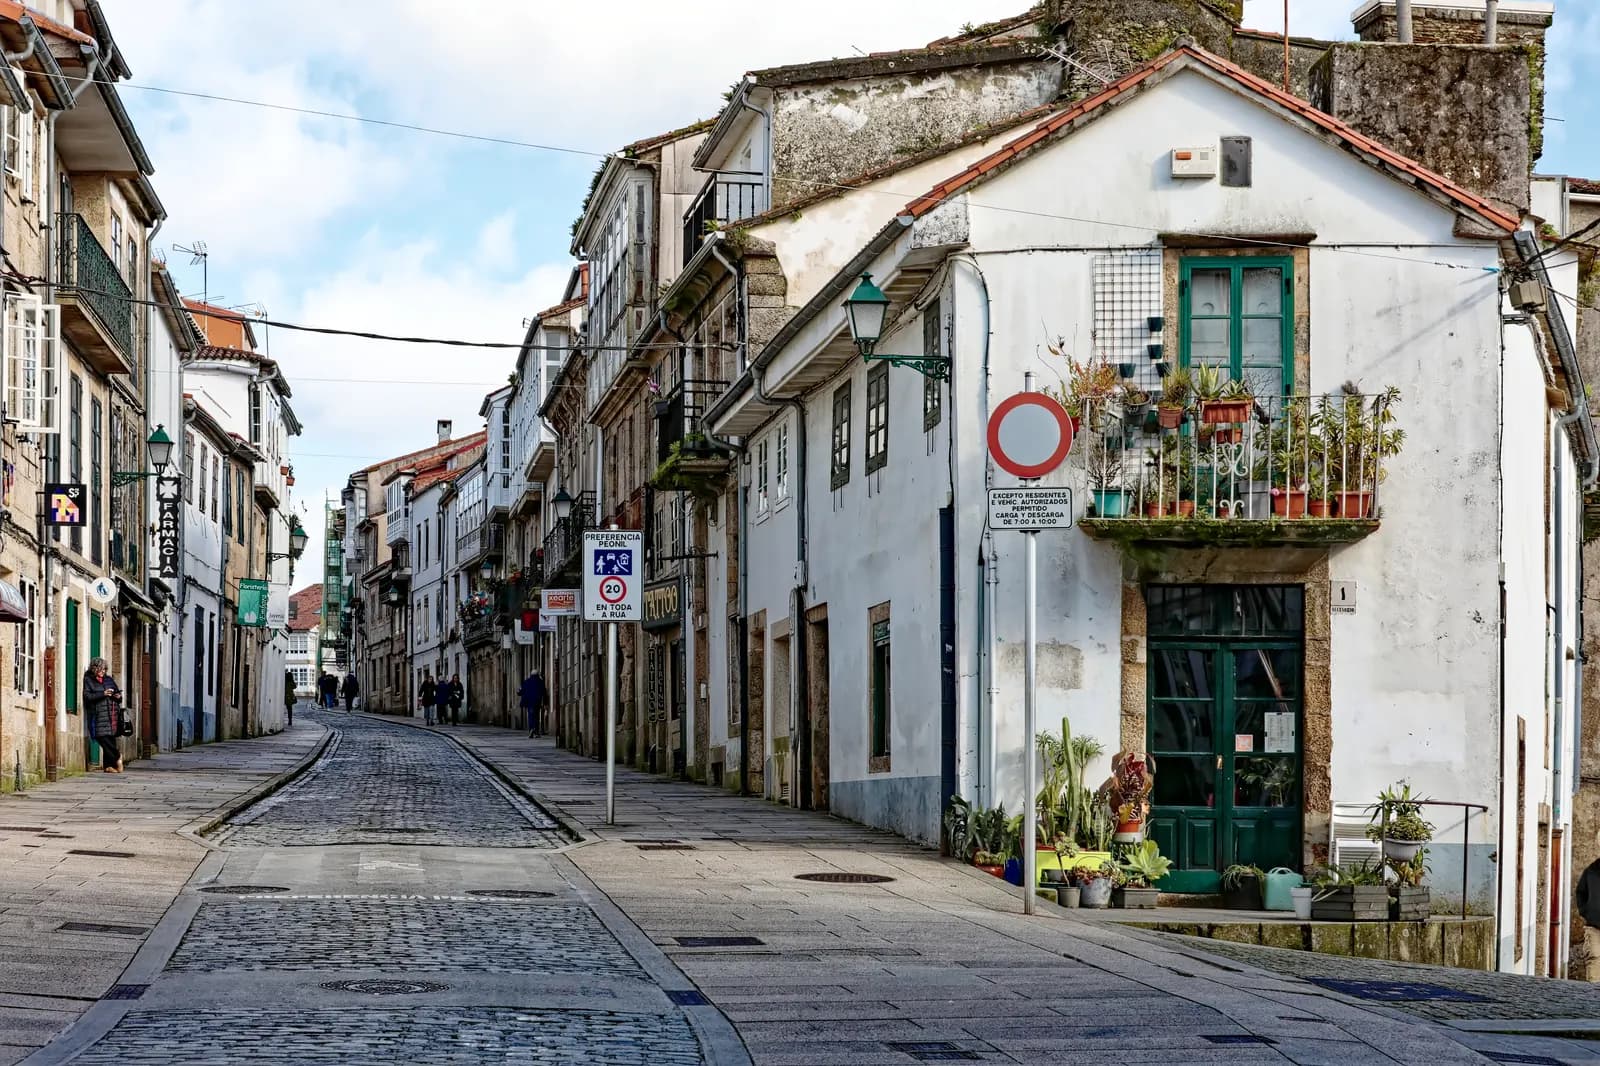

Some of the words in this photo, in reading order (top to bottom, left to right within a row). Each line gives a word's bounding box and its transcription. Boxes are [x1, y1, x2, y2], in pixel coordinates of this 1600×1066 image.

[162, 503, 175, 573] FARMACIA
[585, 533, 641, 541] PREFERENCIA
[605, 585, 620, 593] 20
[1341, 587, 1346, 600] 1
[644, 585, 677, 621] TATTOO
